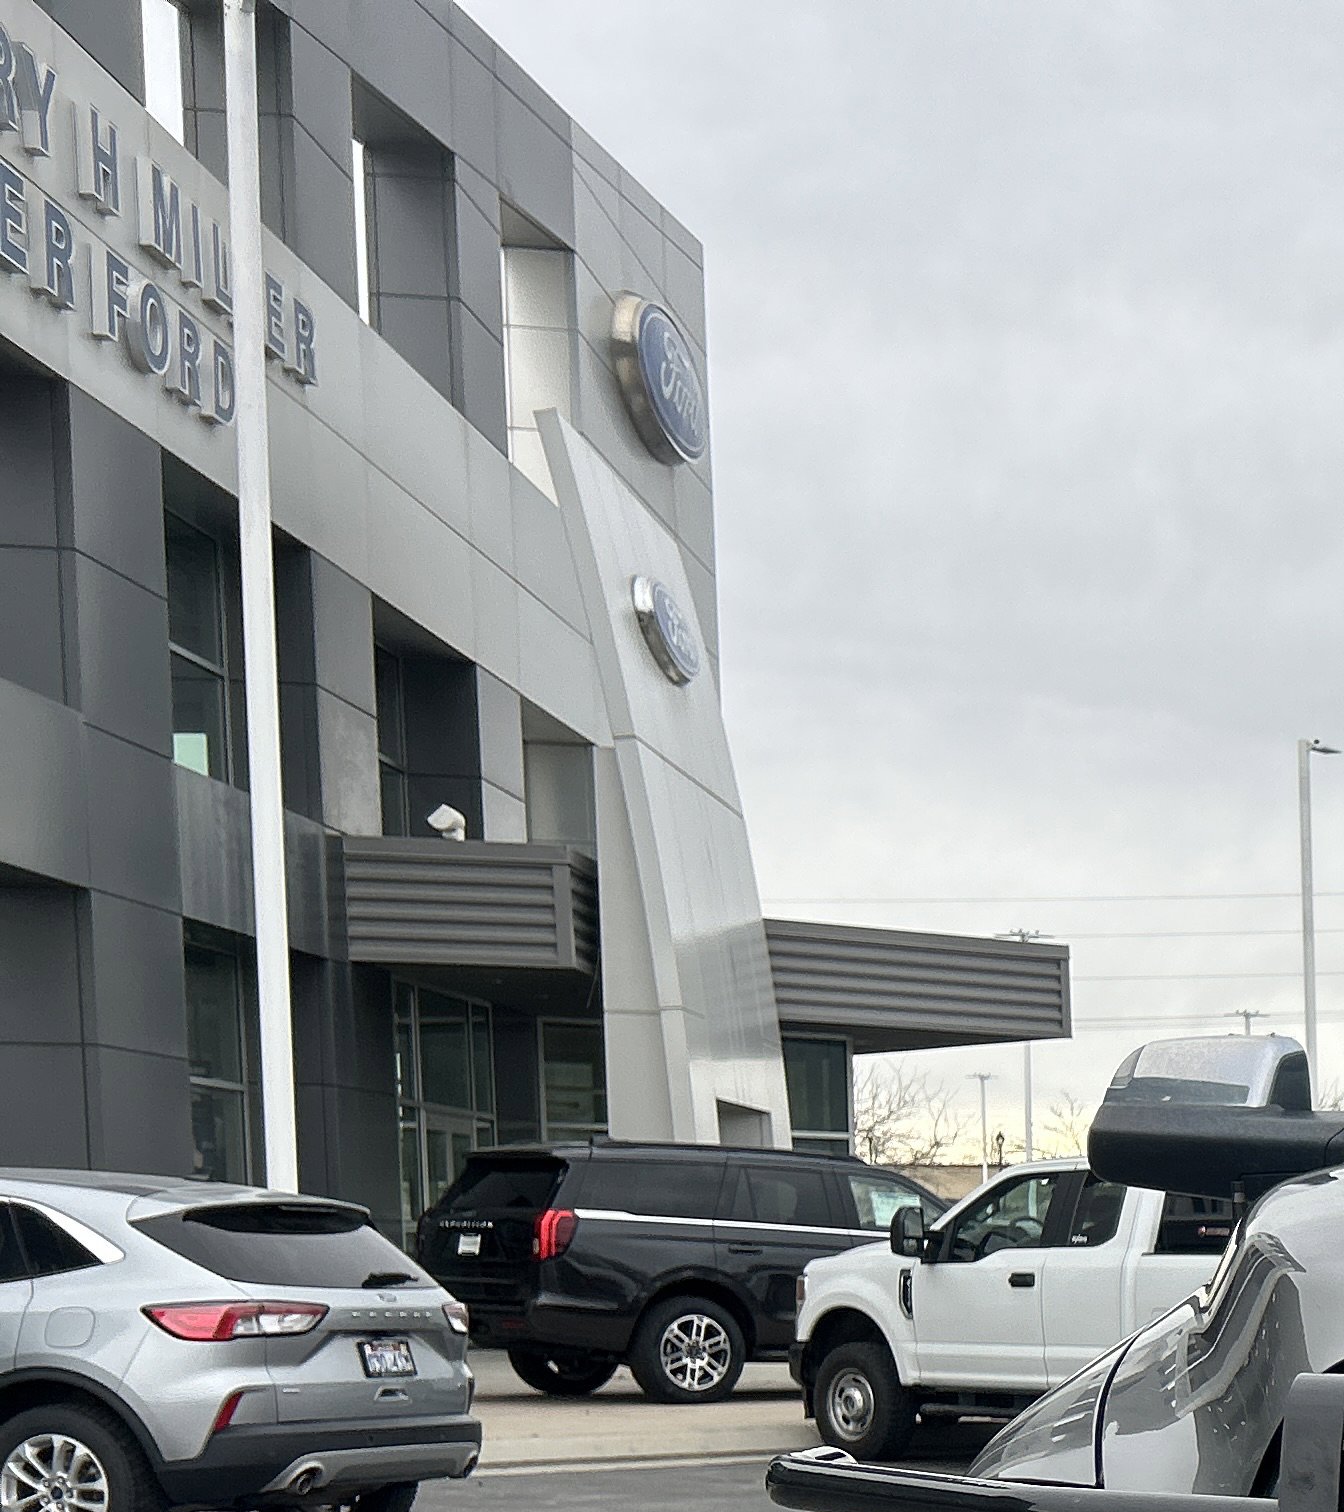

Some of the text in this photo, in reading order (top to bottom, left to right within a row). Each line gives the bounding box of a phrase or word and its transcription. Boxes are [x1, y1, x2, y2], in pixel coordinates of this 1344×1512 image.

[79, 103, 121, 217] H
[143, 157, 319, 387] MILER
[97, 249, 237, 424] FORD
[660, 331, 702, 438] Ford
